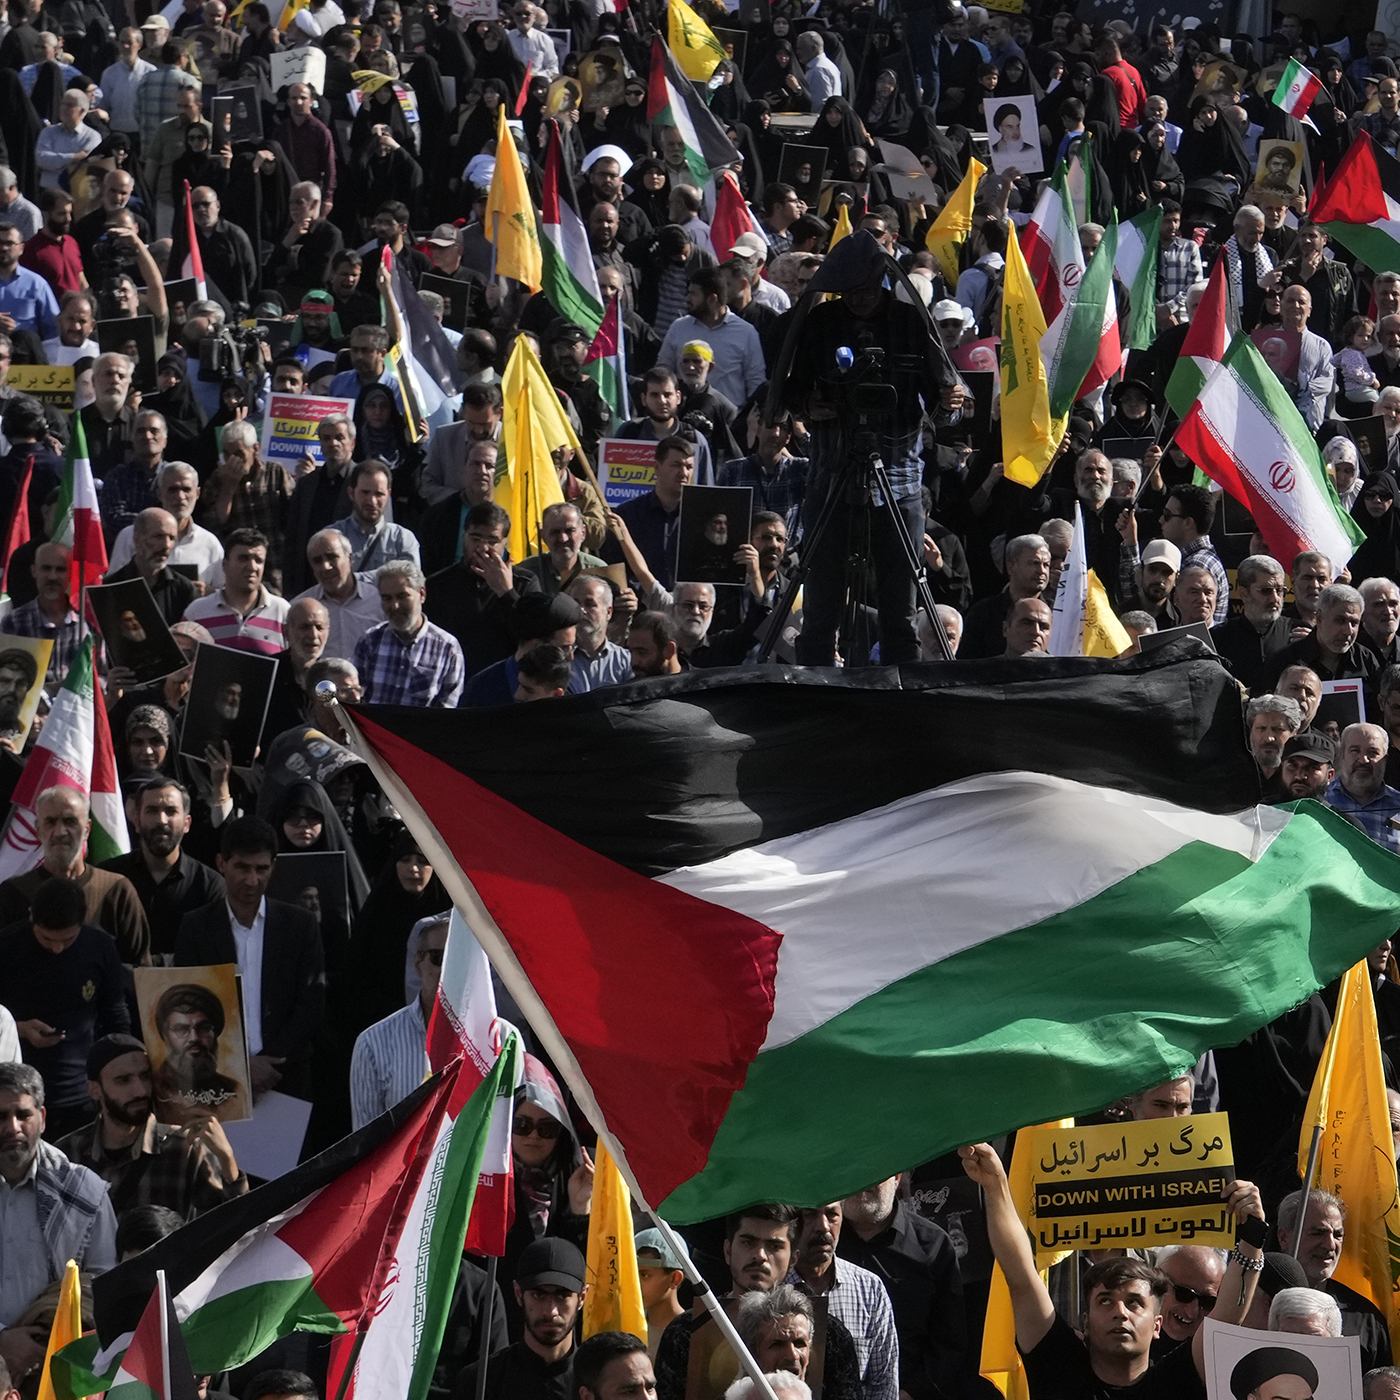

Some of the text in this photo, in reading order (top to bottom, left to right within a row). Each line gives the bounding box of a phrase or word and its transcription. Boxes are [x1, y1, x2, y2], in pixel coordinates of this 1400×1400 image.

[26, 371, 71, 388] مرگ بر
[271, 441, 303, 453] DOWN
[610, 466, 648, 482] آمریکا
[606, 488, 639, 498] DOWN
[1040, 1125, 1223, 1175] مرگ بر اسرائیل
[1038, 1189, 1099, 1208] DOWN
[1105, 1184, 1155, 1202] WITH
[1154, 1210, 1233, 1239] الموت
